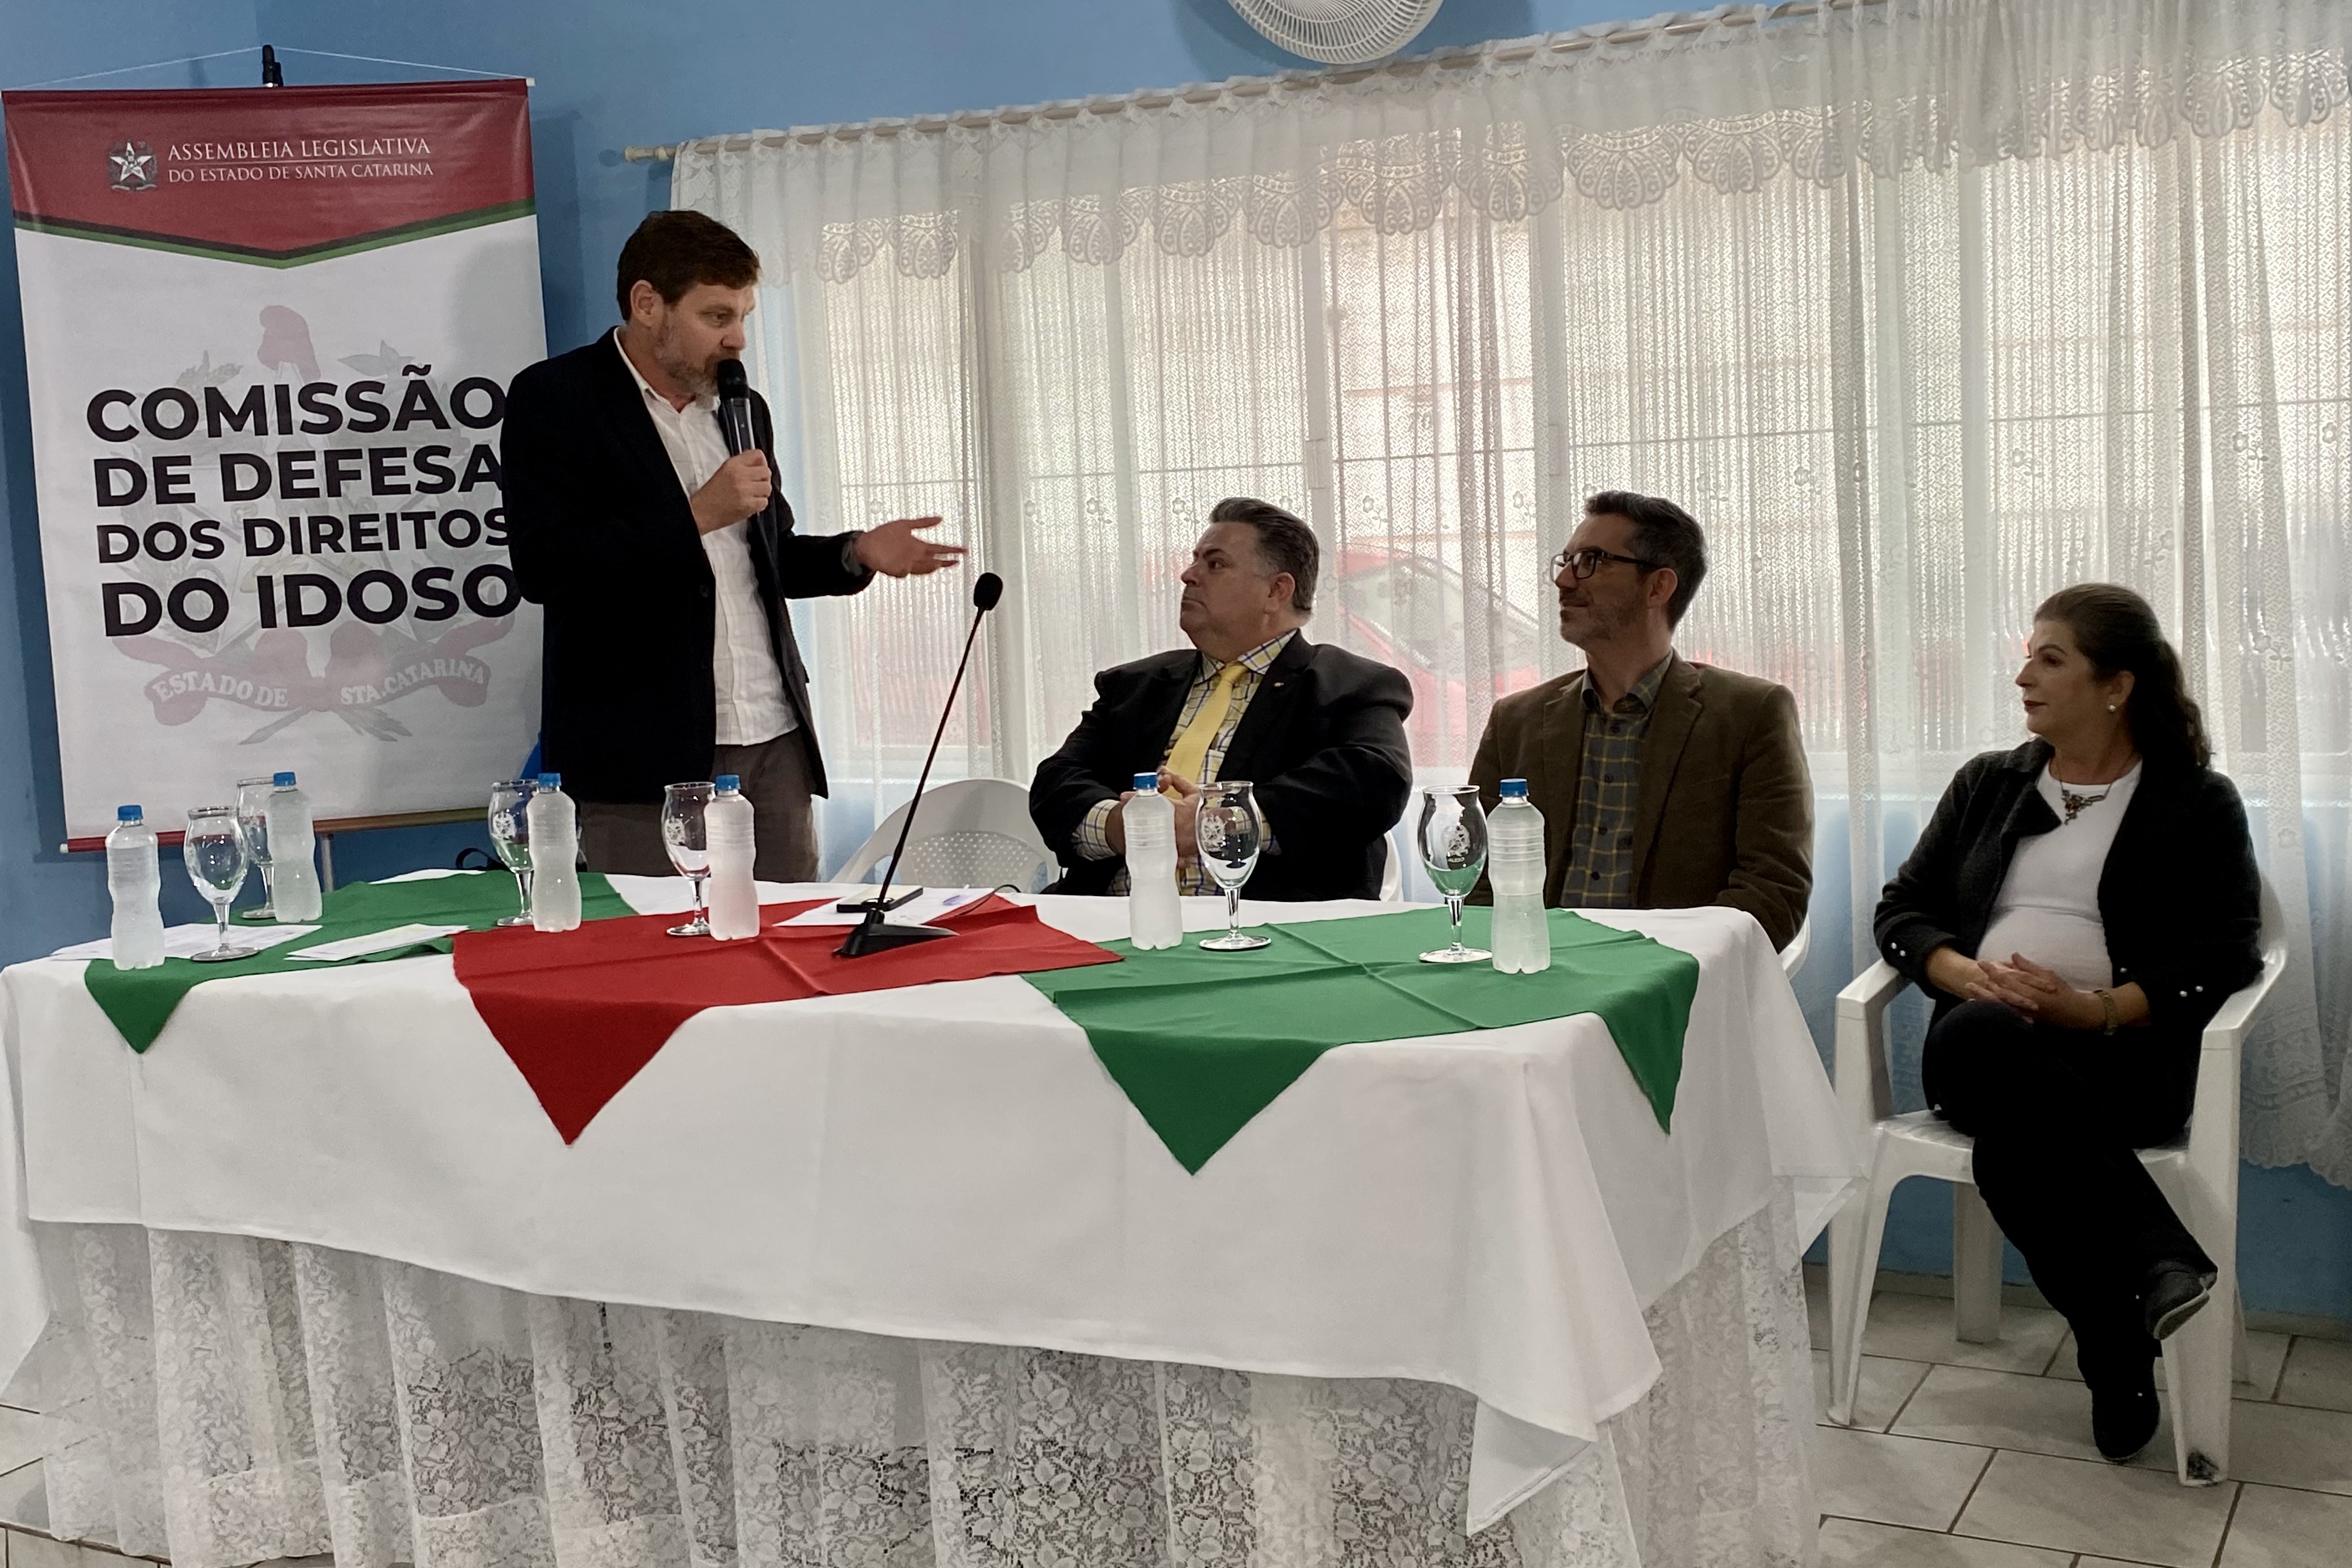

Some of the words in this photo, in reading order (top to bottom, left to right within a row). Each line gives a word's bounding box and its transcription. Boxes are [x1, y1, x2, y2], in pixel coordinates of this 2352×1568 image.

[168, 141, 293, 161] ASSEMBLEIA
[301, 138, 430, 157] LEGISLATIVA
[169, 169, 194, 182] DO
[200, 167, 262, 181] ESTADO
[269, 166, 290, 180] DE
[295, 164, 346, 179] SANTA
[351, 163, 434, 177] CATARINA
[86, 364, 506, 442] COMISSÃO
[93, 455, 196, 507] DE
[220, 444, 502, 502] DEFESA
[96, 519, 225, 564] DOS
[243, 508, 509, 556] DIREITOS
[101, 578, 229, 636] DO
[256, 564, 522, 629] IDOSO
[152, 671, 254, 702] ESTADO
[254, 686, 288, 708] DE
